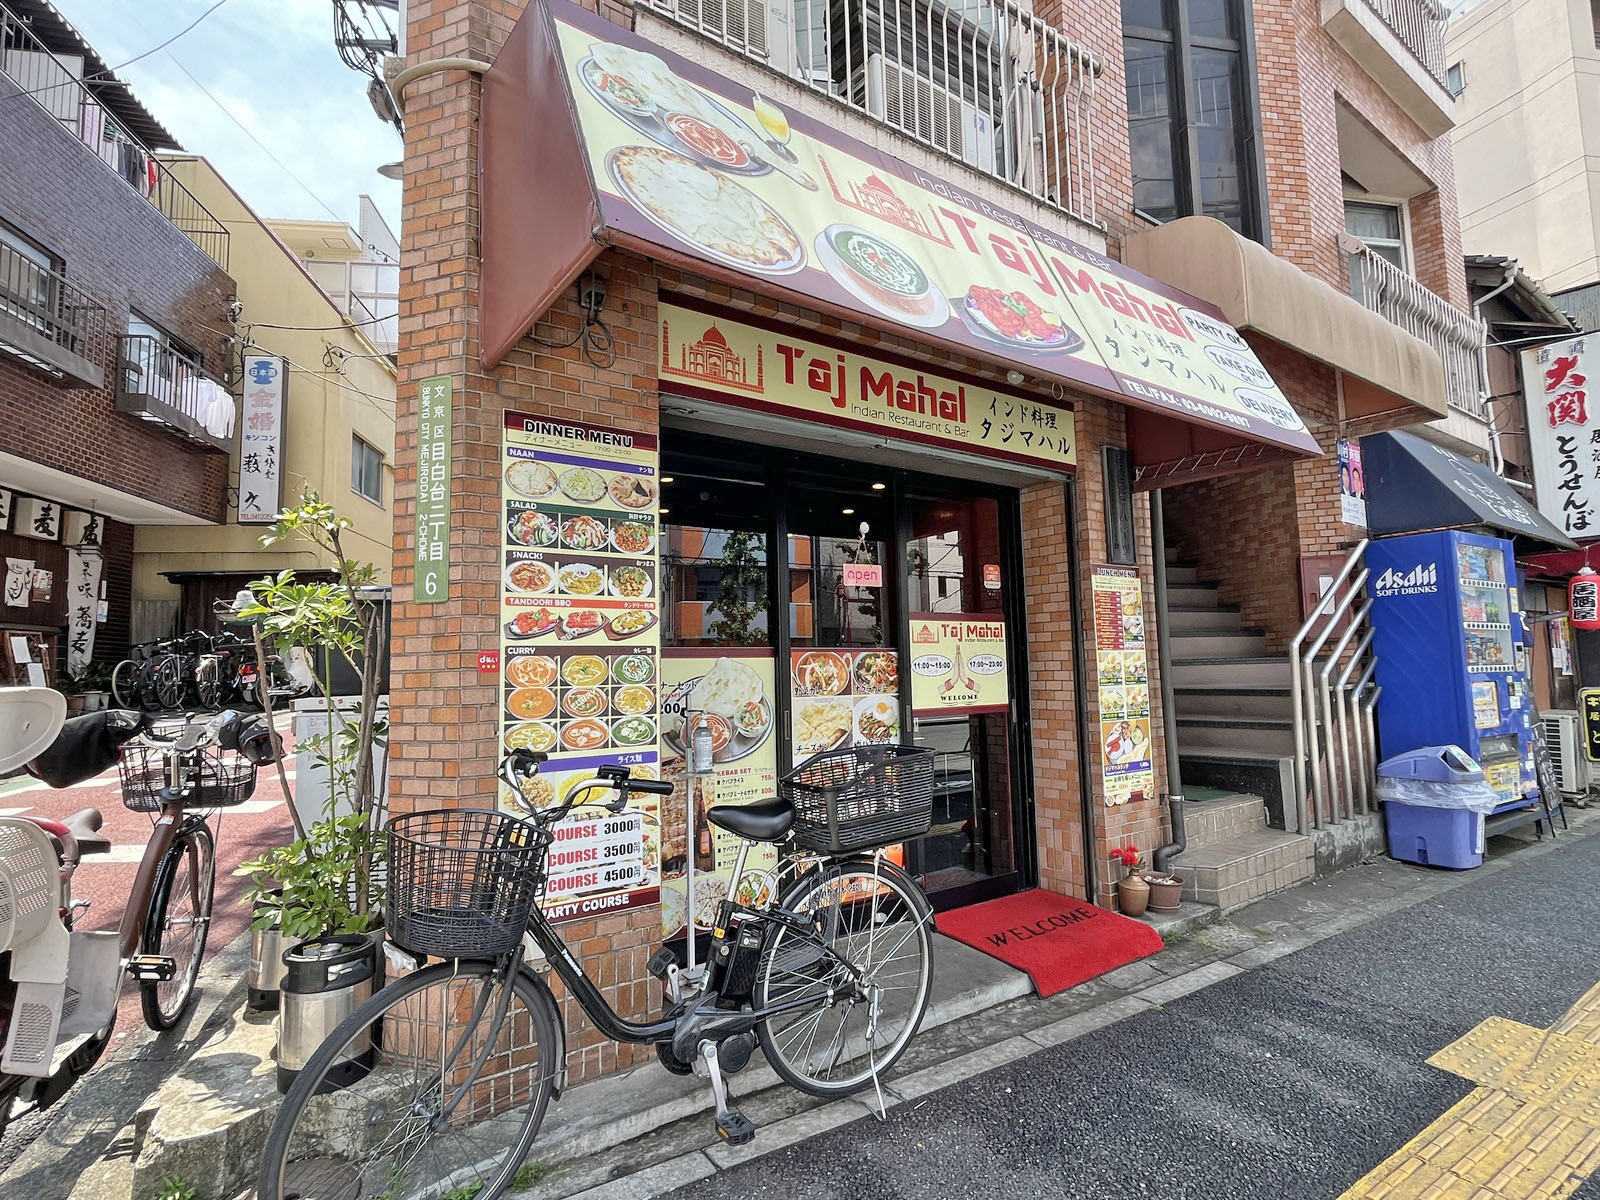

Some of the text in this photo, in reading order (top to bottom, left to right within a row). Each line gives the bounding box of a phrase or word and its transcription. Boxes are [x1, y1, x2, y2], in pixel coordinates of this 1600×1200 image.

[913, 170, 1112, 272] Indian Restaurant & Bar
[938, 205, 1195, 343] Taj Mahal
[1113, 318, 1189, 358] インド料理
[1185, 315, 1226, 342] PARTY
[250, 368, 276, 377] 日本酒
[1104, 334, 1225, 394] タジマハル
[1209, 351, 1269, 382] TAKE OUT
[776, 343, 967, 424] Taj Mahal
[1545, 355, 1588, 427] 大関
[248, 388, 276, 431] 金婚
[851, 403, 970, 438] Indian Restaurant & Bar
[989, 396, 1058, 431] インド料理
[1239, 396, 1297, 423] DELIVERY
[245, 434, 277, 442] キンコン
[524, 420, 633, 448] DINNER MENU
[980, 418, 1070, 456] タジマハル
[509, 448, 535, 459] NAAN
[418, 386, 431, 561] BUNKYO CITY MEJIRODAI 2-CHOME
[430, 385, 445, 561] 文京区目白台二丁目
[1556, 435, 1594, 531] とうせんぼ
[510, 501, 537, 510] SALAD
[512, 551, 543, 560] SNACKS
[425, 572, 437, 595] 6
[847, 570, 878, 584] open
[1097, 567, 1137, 578] LUNCH MENU
[1375, 563, 1437, 590] Asahi
[509, 597, 572, 607] TANDOORI BBQ
[1376, 585, 1438, 597] SOFT DRINKS
[1572, 582, 1598, 622] 居酒屋
[941, 622, 1003, 642] Taj Mahal
[941, 694, 978, 702] WELCOME
[604, 820, 633, 834] 3000
[549, 843, 633, 867] COURSE 3500
[548, 873, 598, 892] COURSE
[604, 867, 633, 882] 4500
[542, 893, 630, 920] PARTY COURSE
[986, 907, 1098, 948] WELCOME
